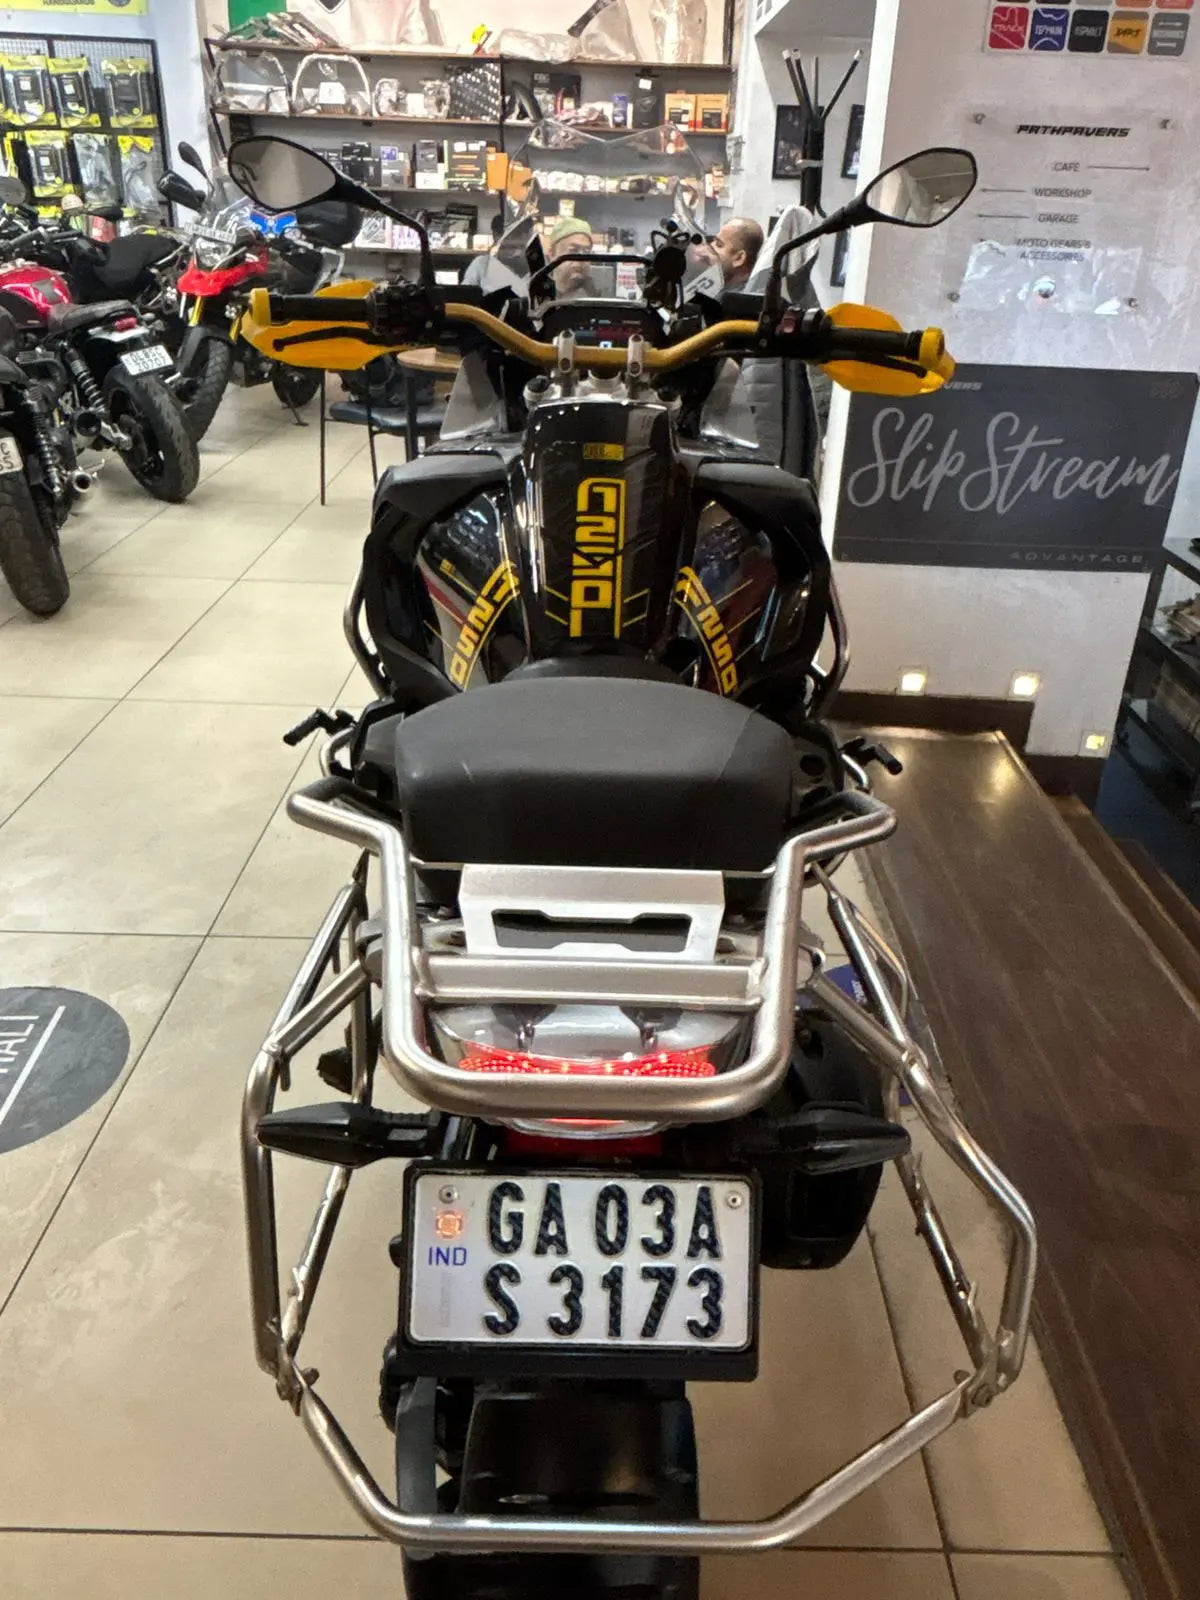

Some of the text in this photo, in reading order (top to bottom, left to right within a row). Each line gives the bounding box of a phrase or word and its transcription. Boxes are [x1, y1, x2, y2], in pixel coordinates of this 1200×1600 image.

[1016, 124, 1131, 137] PATHPAVERS
[1053, 162, 1080, 172] CAFE
[1033, 187, 1092, 198] WORKSHOP
[1037, 213, 1080, 223] GARAGE
[1009, 552, 1143, 563] ADVANTAGE
[488, 1181, 722, 1259] GA 03A
[428, 1247, 468, 1266] IND
[483, 1262, 724, 1339] S 3173
